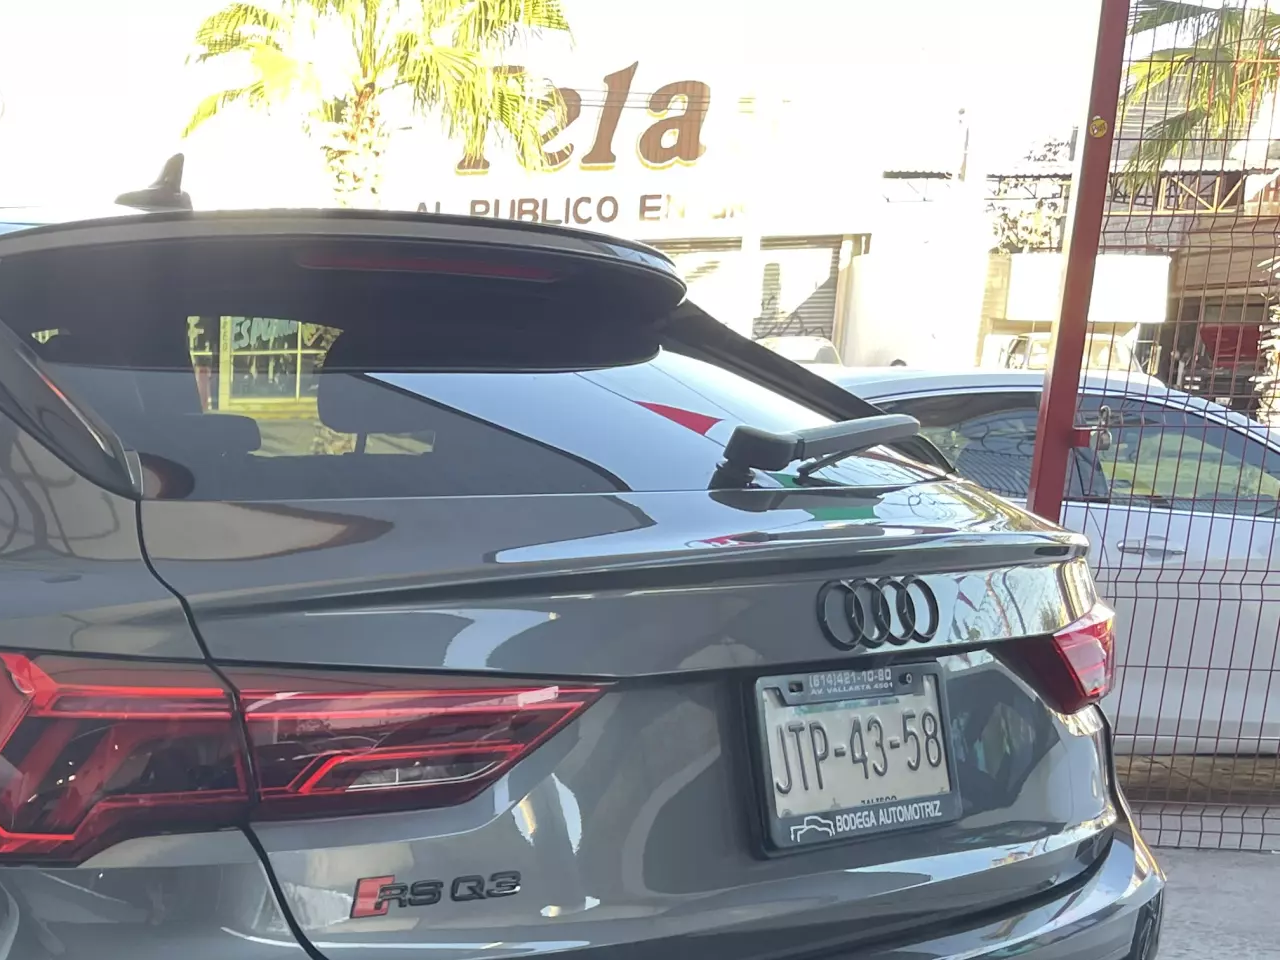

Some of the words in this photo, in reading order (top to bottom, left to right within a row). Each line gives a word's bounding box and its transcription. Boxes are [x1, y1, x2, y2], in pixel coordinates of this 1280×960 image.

[456, 61, 710, 174] ela
[470, 196, 618, 224] PUBLICO
[775, 709, 942, 795] JTP-43-58
[835, 810, 877, 833] BODEGA
[879, 800, 942, 826] AUTOMOTRIZ
[372, 879, 444, 910] RS
[450, 870, 522, 902] Q3
